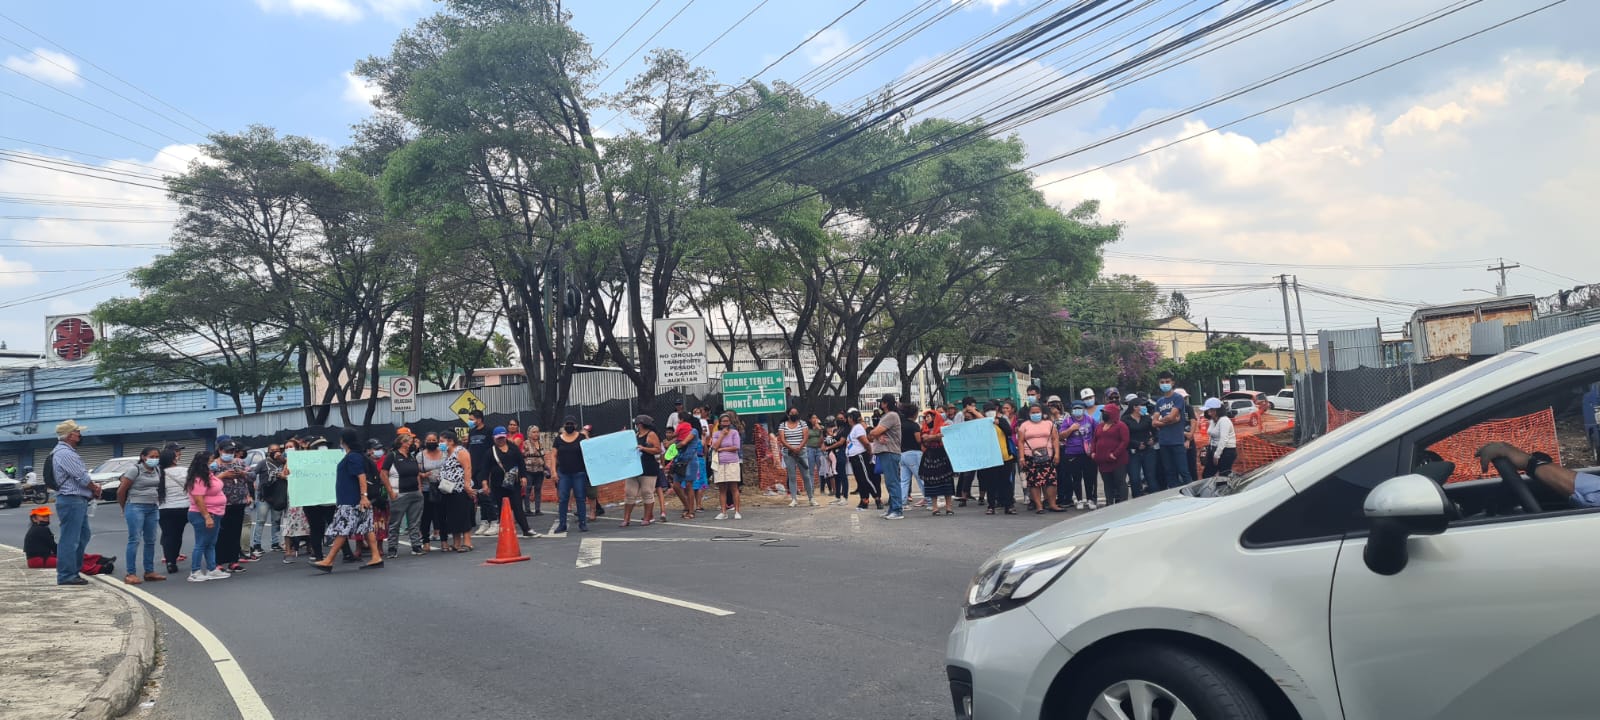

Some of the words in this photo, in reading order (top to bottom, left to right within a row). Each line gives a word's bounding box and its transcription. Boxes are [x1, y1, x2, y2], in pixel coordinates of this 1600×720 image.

[725, 378, 748, 387] TORRE
[749, 376, 775, 386] TERUEL
[725, 399, 751, 409] MONTE
[752, 398, 776, 408] MARIA
